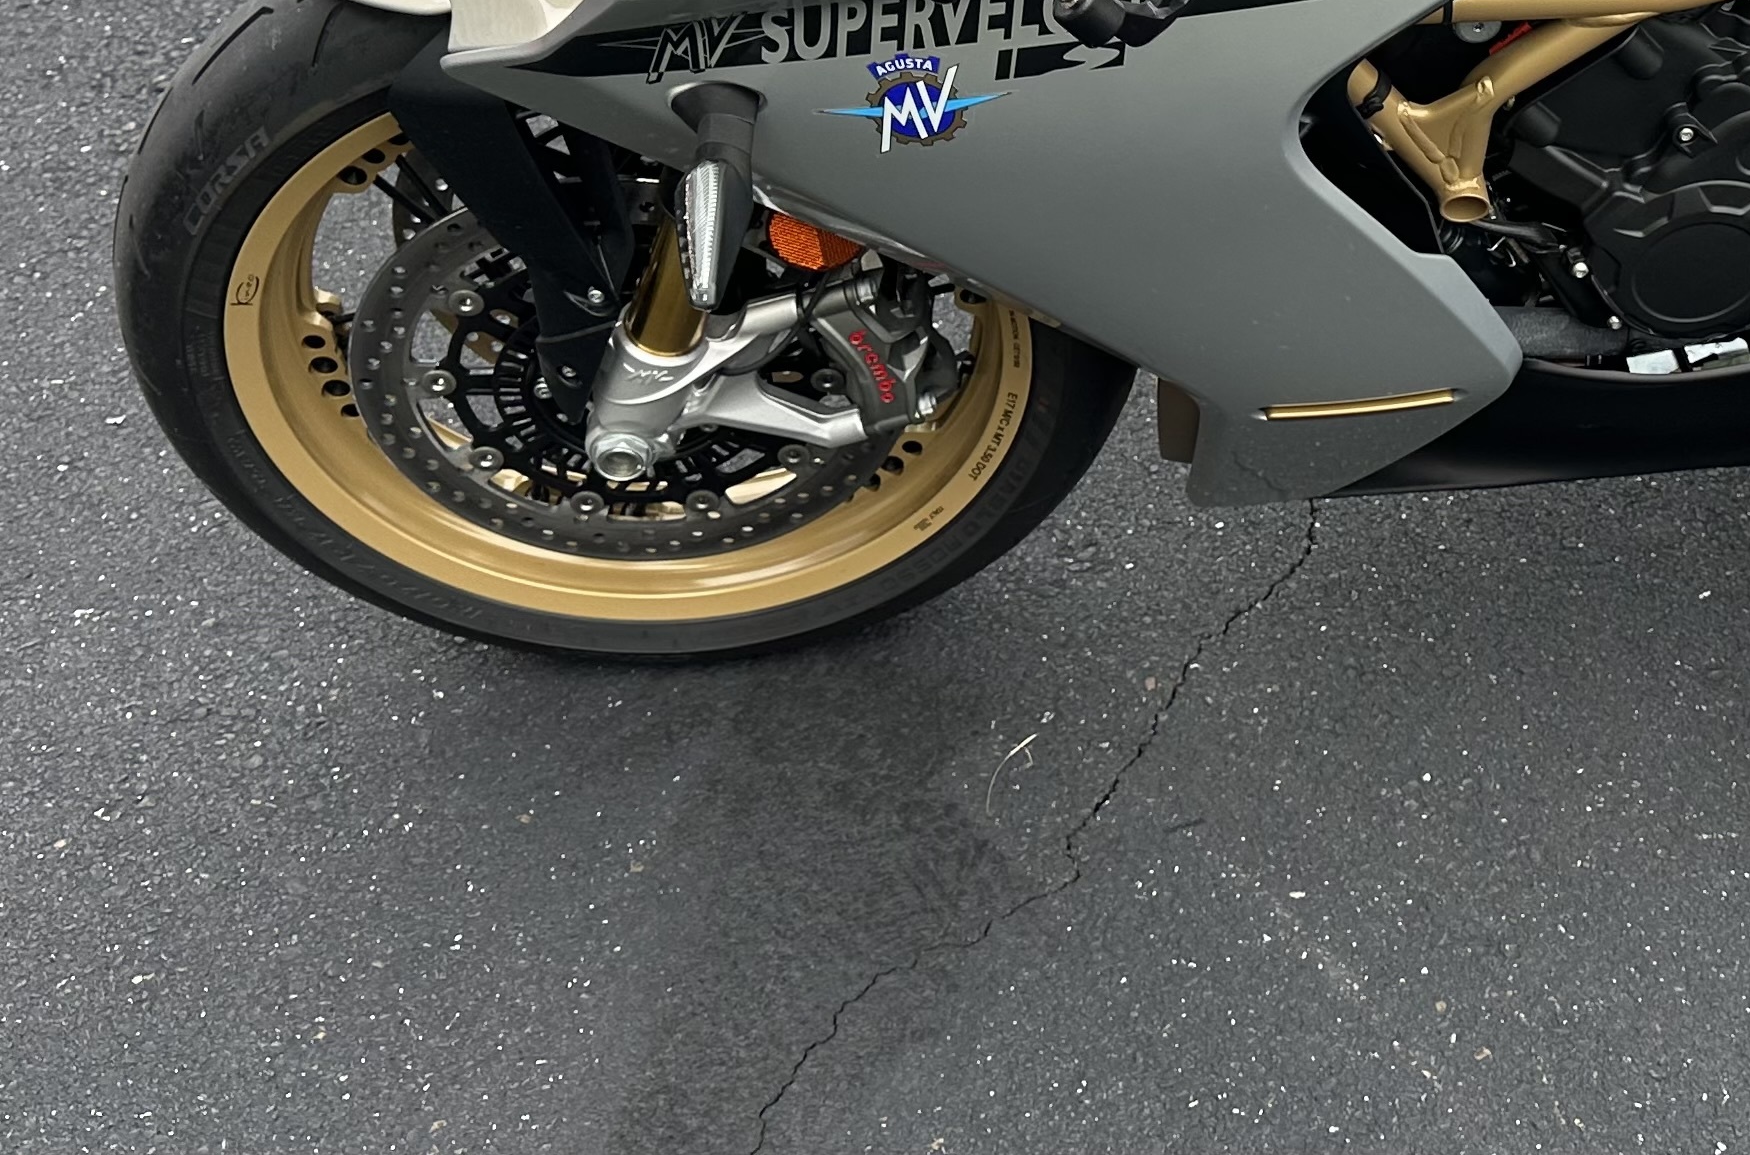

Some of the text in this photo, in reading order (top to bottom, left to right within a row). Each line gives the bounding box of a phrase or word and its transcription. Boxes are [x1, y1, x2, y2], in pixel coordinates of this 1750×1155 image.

[876, 58, 933, 77] AGUSTA
[880, 63, 959, 153] MV
[183, 125, 271, 235] CORSA
[848, 329, 896, 403] brembo
[968, 462, 986, 482] DOT
